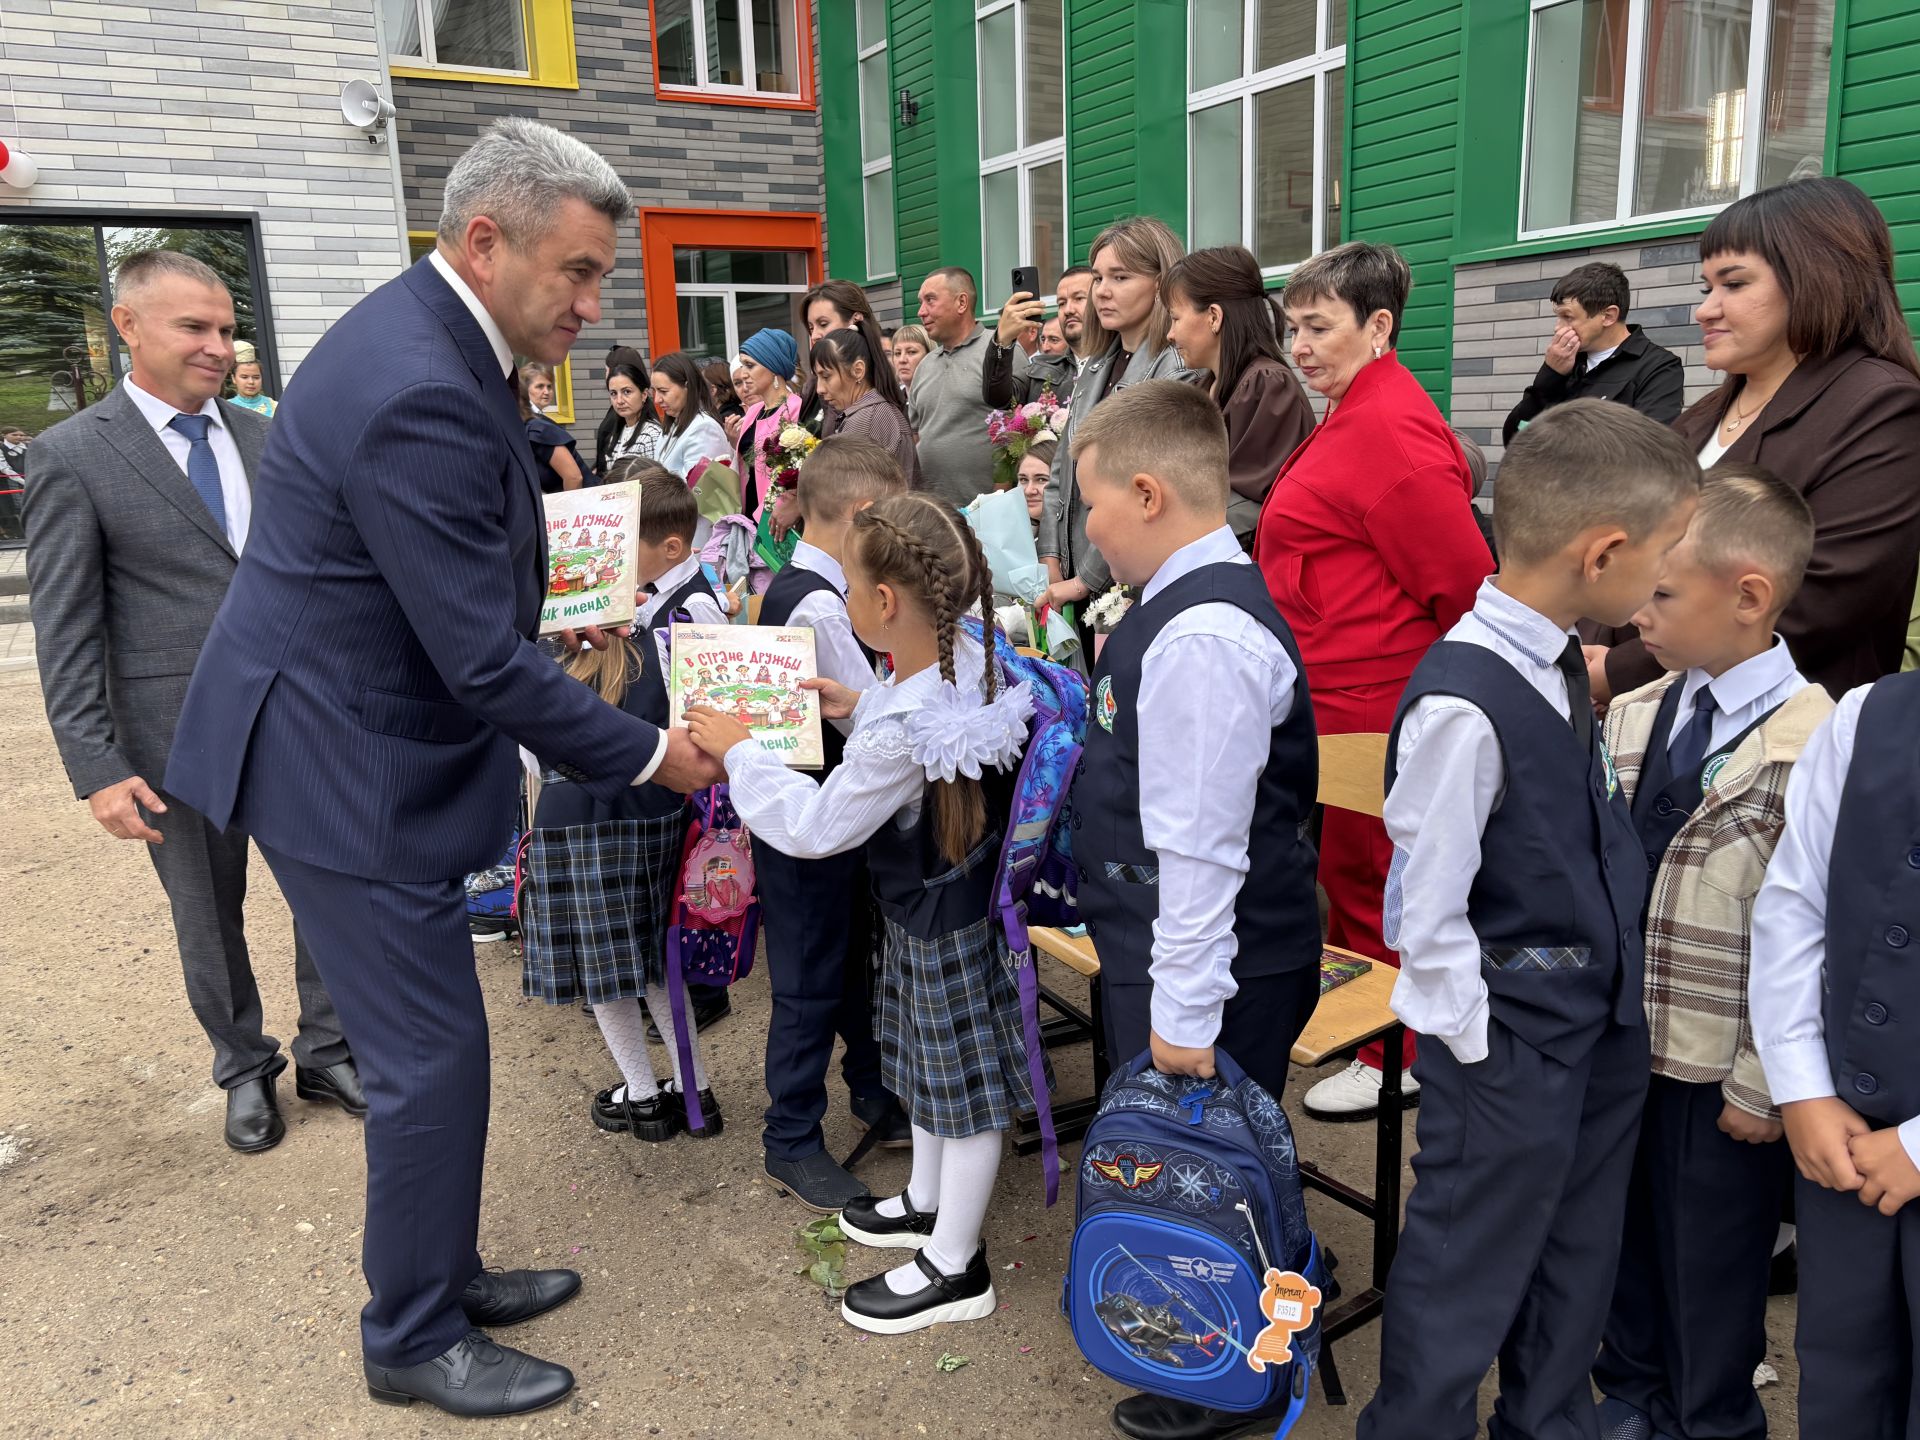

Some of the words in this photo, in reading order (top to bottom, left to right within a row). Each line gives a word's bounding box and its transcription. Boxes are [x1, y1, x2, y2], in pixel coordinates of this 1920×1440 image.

[572, 513, 624, 529] ДРУЖБЫ
[749, 650, 802, 671] ДРУЖБЫ
[1276, 1304, 1297, 1317] F3512
